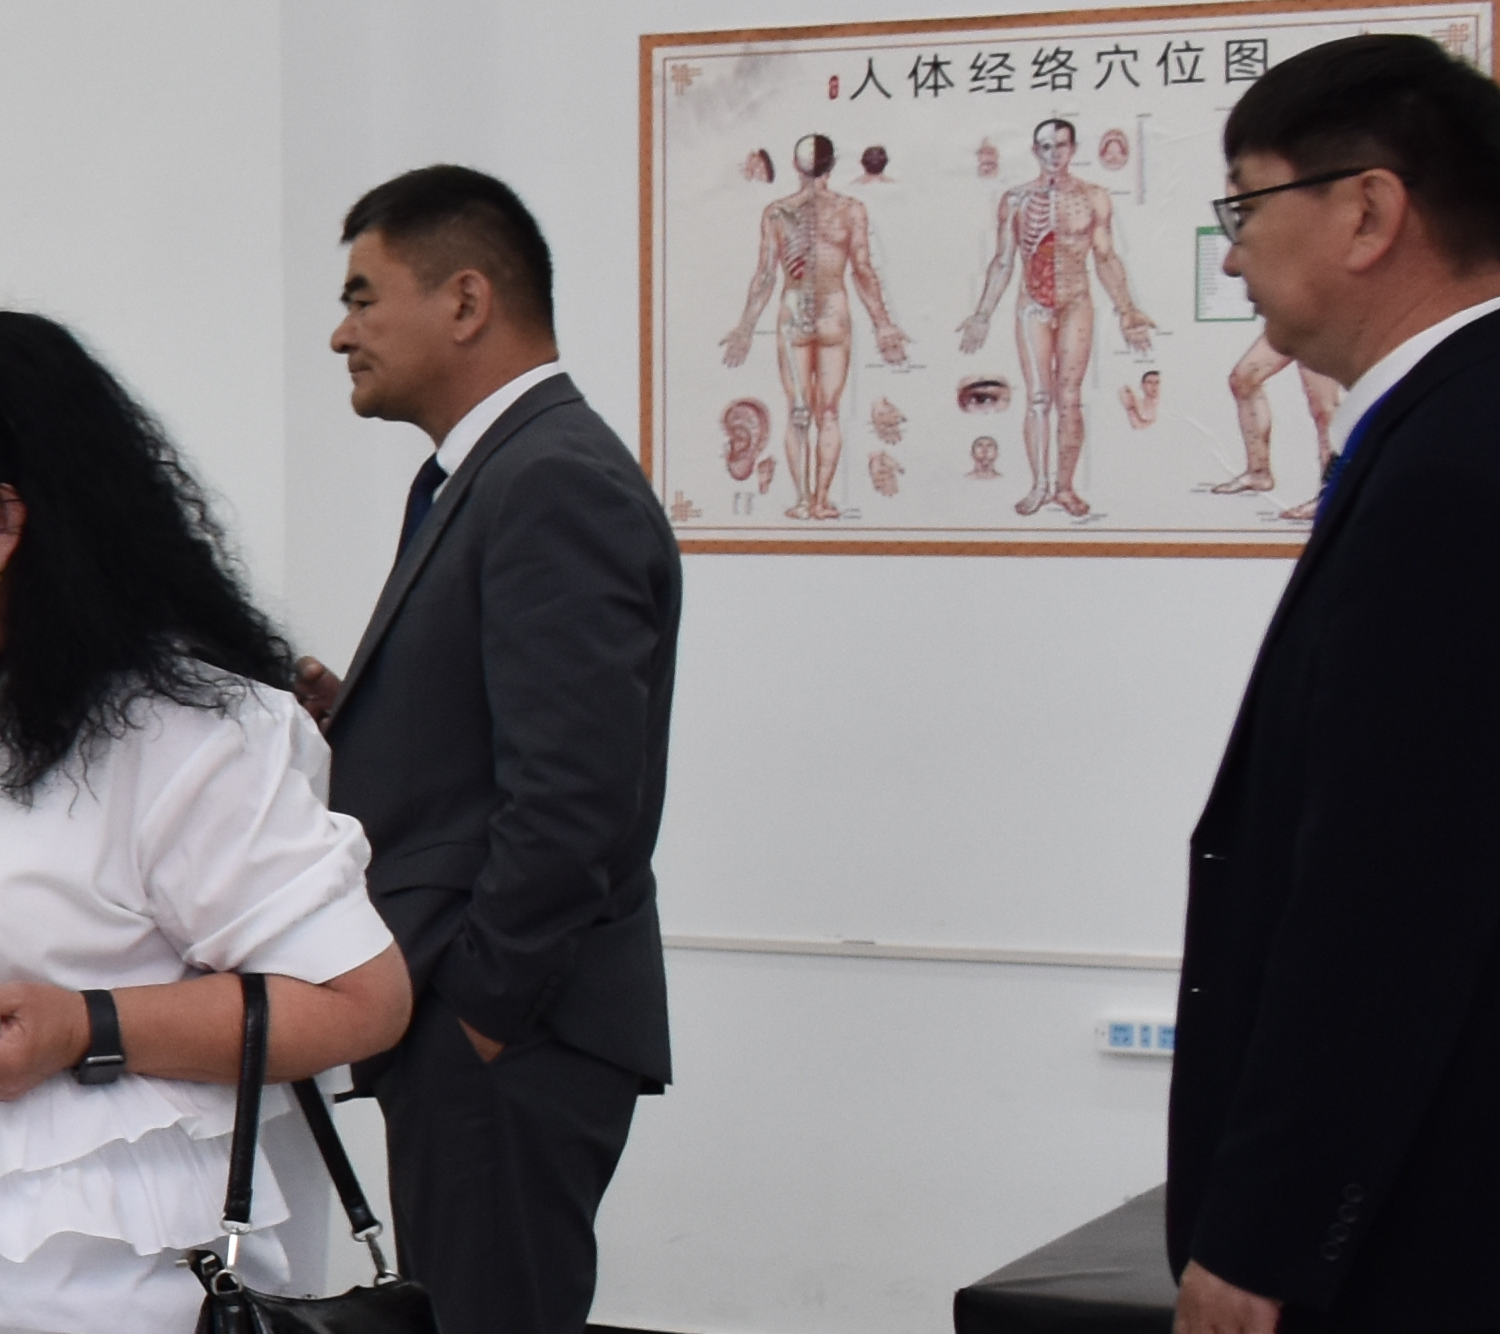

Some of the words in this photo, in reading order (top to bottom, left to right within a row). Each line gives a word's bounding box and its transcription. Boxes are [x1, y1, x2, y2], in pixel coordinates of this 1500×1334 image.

[850, 38, 1268, 100] 人体经络穴位图
